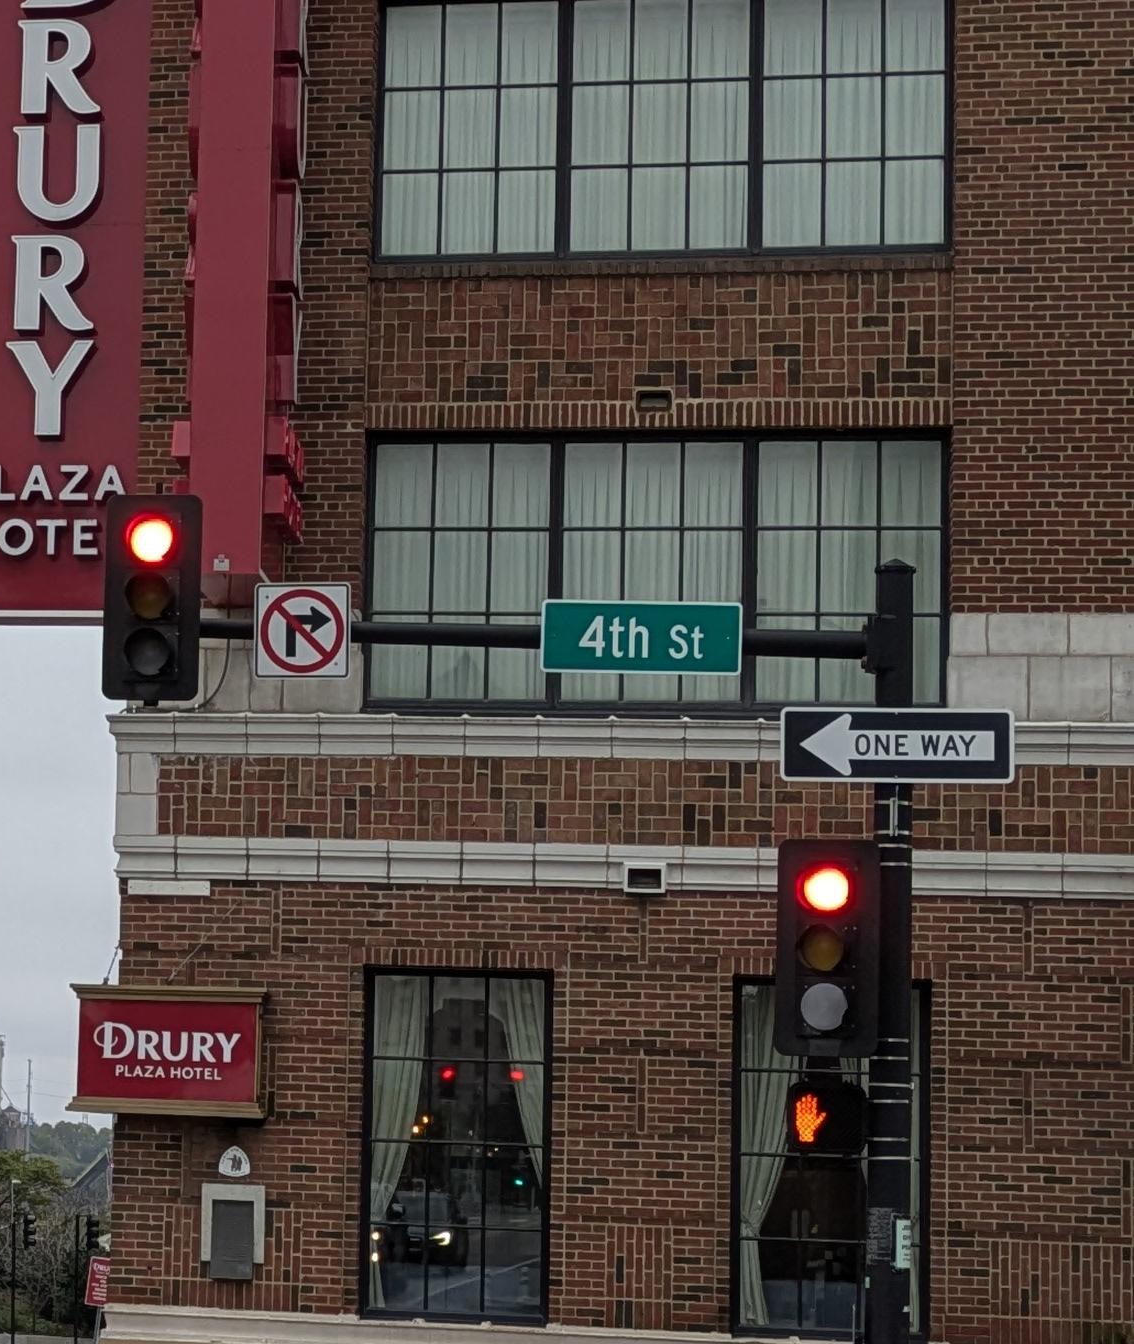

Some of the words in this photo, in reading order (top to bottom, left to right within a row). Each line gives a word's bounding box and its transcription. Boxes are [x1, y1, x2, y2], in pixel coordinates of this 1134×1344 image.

[578, 615, 649, 658] 4th
[668, 624, 704, 659] St
[855, 733, 909, 756] ONE
[921, 734, 977, 757] WAY
[93, 1021, 241, 1063] DRURY
[115, 1064, 166, 1079] PLAZA
[170, 1066, 222, 1081] HOTEL
